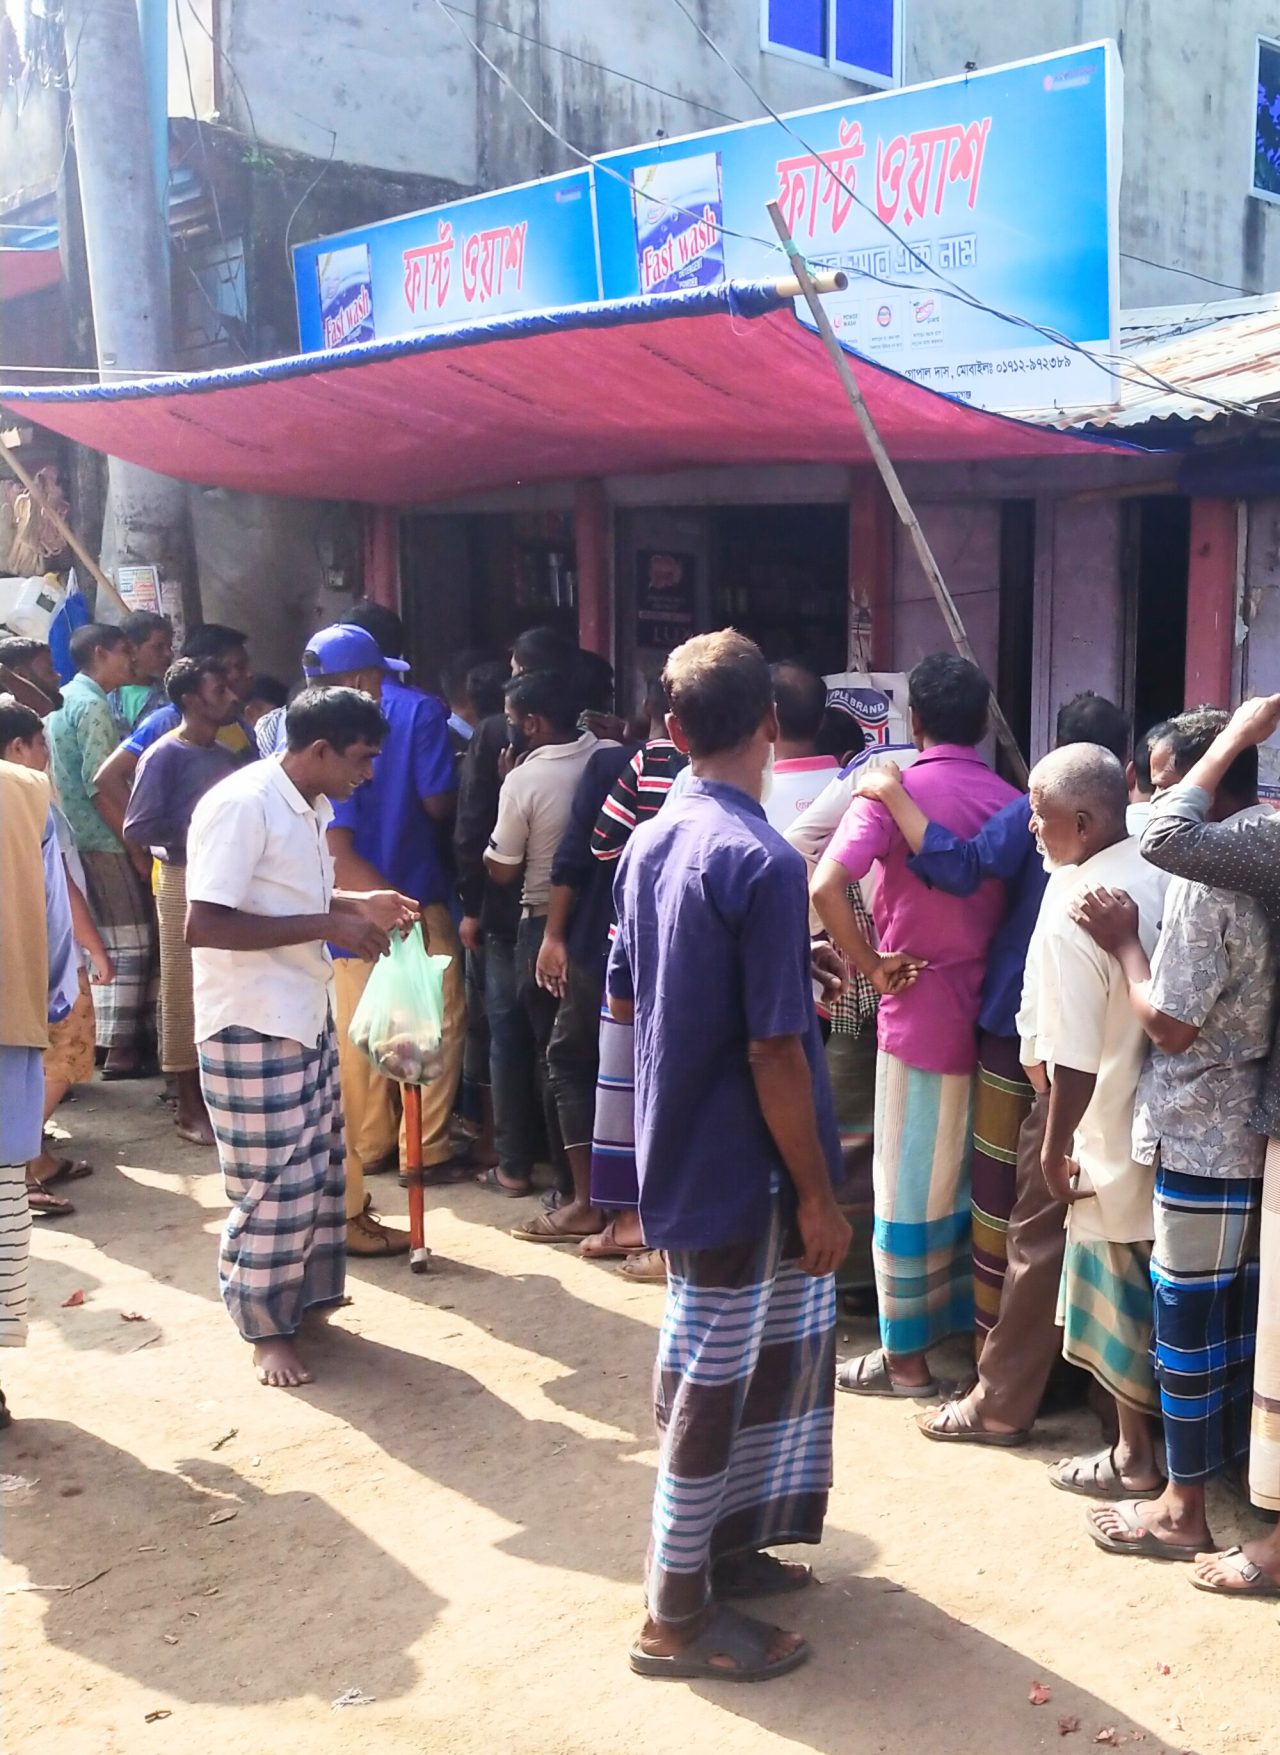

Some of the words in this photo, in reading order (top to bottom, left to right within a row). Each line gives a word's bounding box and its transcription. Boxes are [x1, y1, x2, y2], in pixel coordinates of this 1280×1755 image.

[775, 117, 865, 237] ফাস্ট
[876, 116, 992, 226] ওয়াশ
[402, 218, 454, 313] ফাস্ট
[460, 220, 528, 303] ওয়াশ
[643, 237, 675, 287] Fast
[679, 206, 716, 264] wash
[938, 233, 977, 270] নাম
[326, 309, 345, 347] Fast
[346, 286, 369, 329] wash
[996, 355, 1072, 374] ০১৭১২-৯৭২৩৮৯
[850, 697, 885, 714] BRAND
